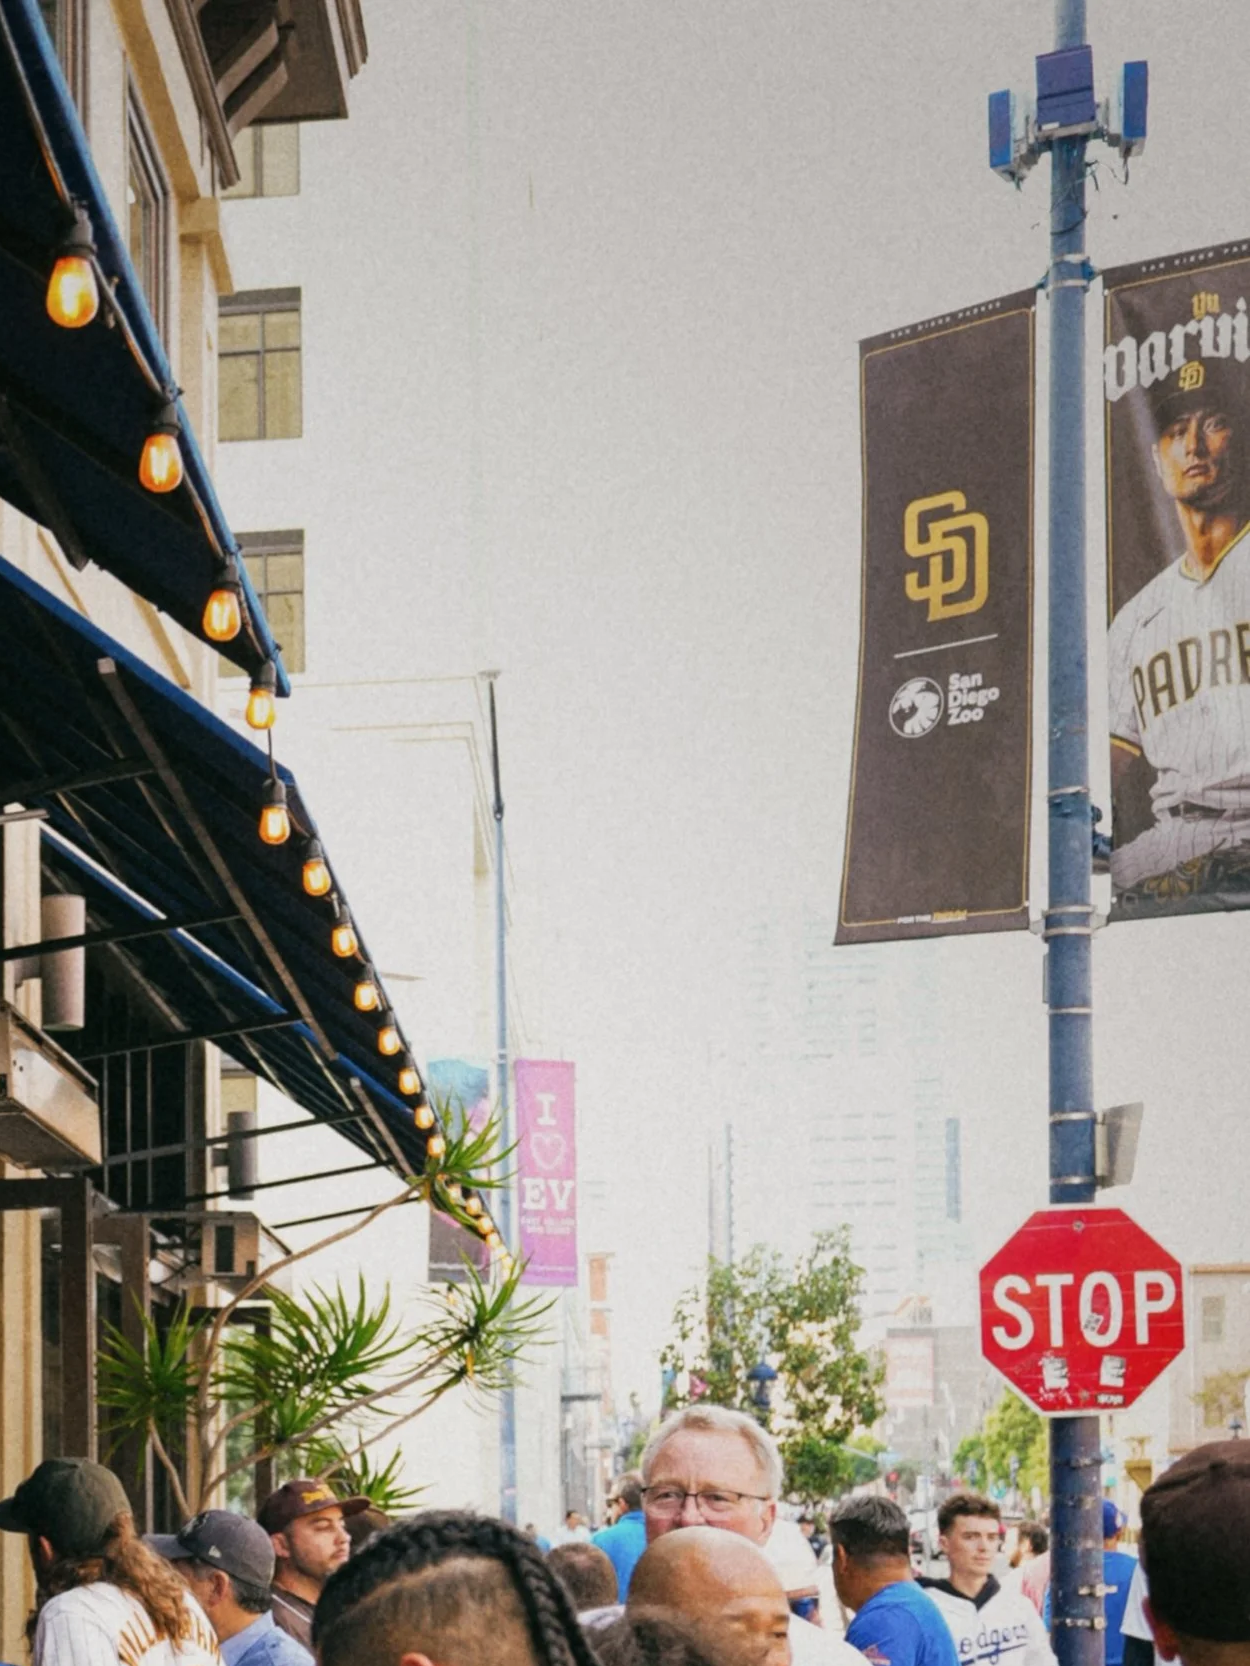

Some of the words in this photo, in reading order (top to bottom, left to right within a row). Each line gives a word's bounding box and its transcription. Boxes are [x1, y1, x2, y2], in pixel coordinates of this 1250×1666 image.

[948, 672, 983, 691] San
[948, 686, 1000, 708] Diego
[947, 708, 984, 726] Zoo
[535, 1092, 558, 1126] I
[521, 1177, 575, 1211] EV
[991, 1270, 1177, 1351] STOP
[958, 1622, 1030, 1666] odgers
